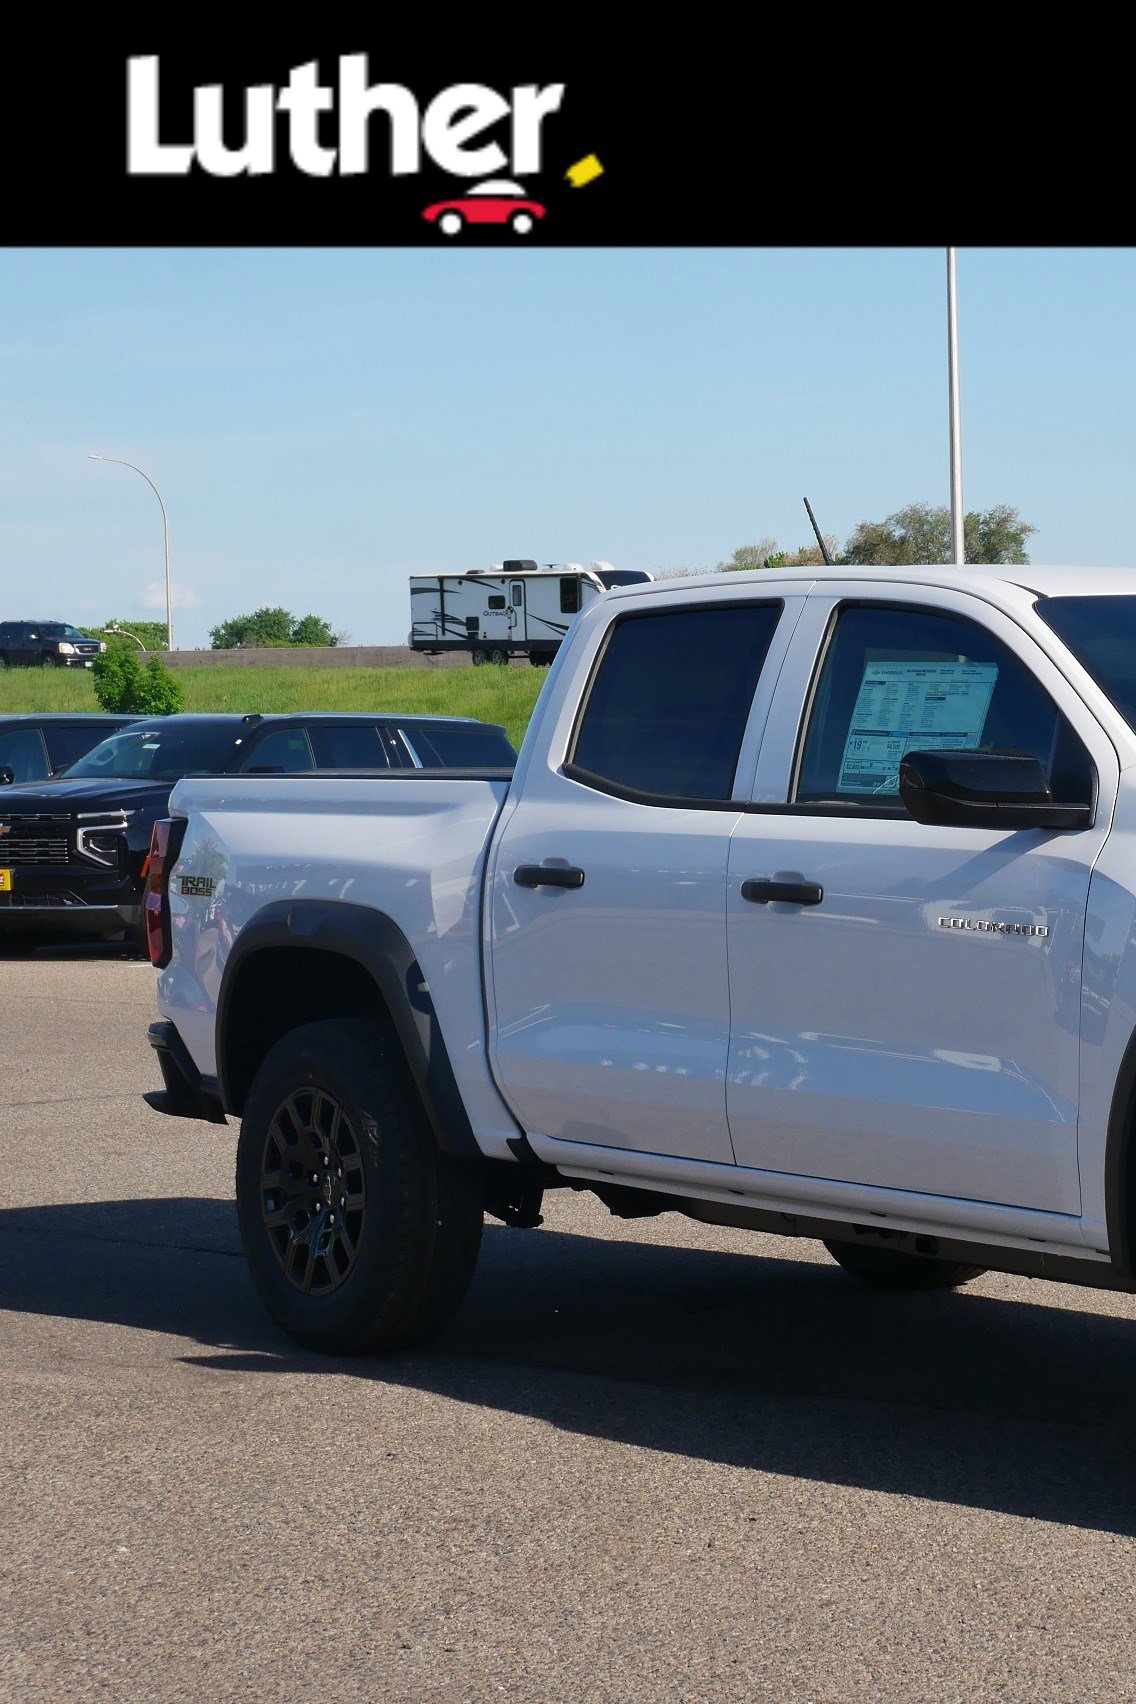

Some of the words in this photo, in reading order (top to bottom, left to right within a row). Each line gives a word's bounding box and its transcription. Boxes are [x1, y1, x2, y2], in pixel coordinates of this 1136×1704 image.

[176, 875, 217, 888] TRAIL
[181, 887, 213, 897] BOSS
[937, 916, 1050, 937] COLORADO
